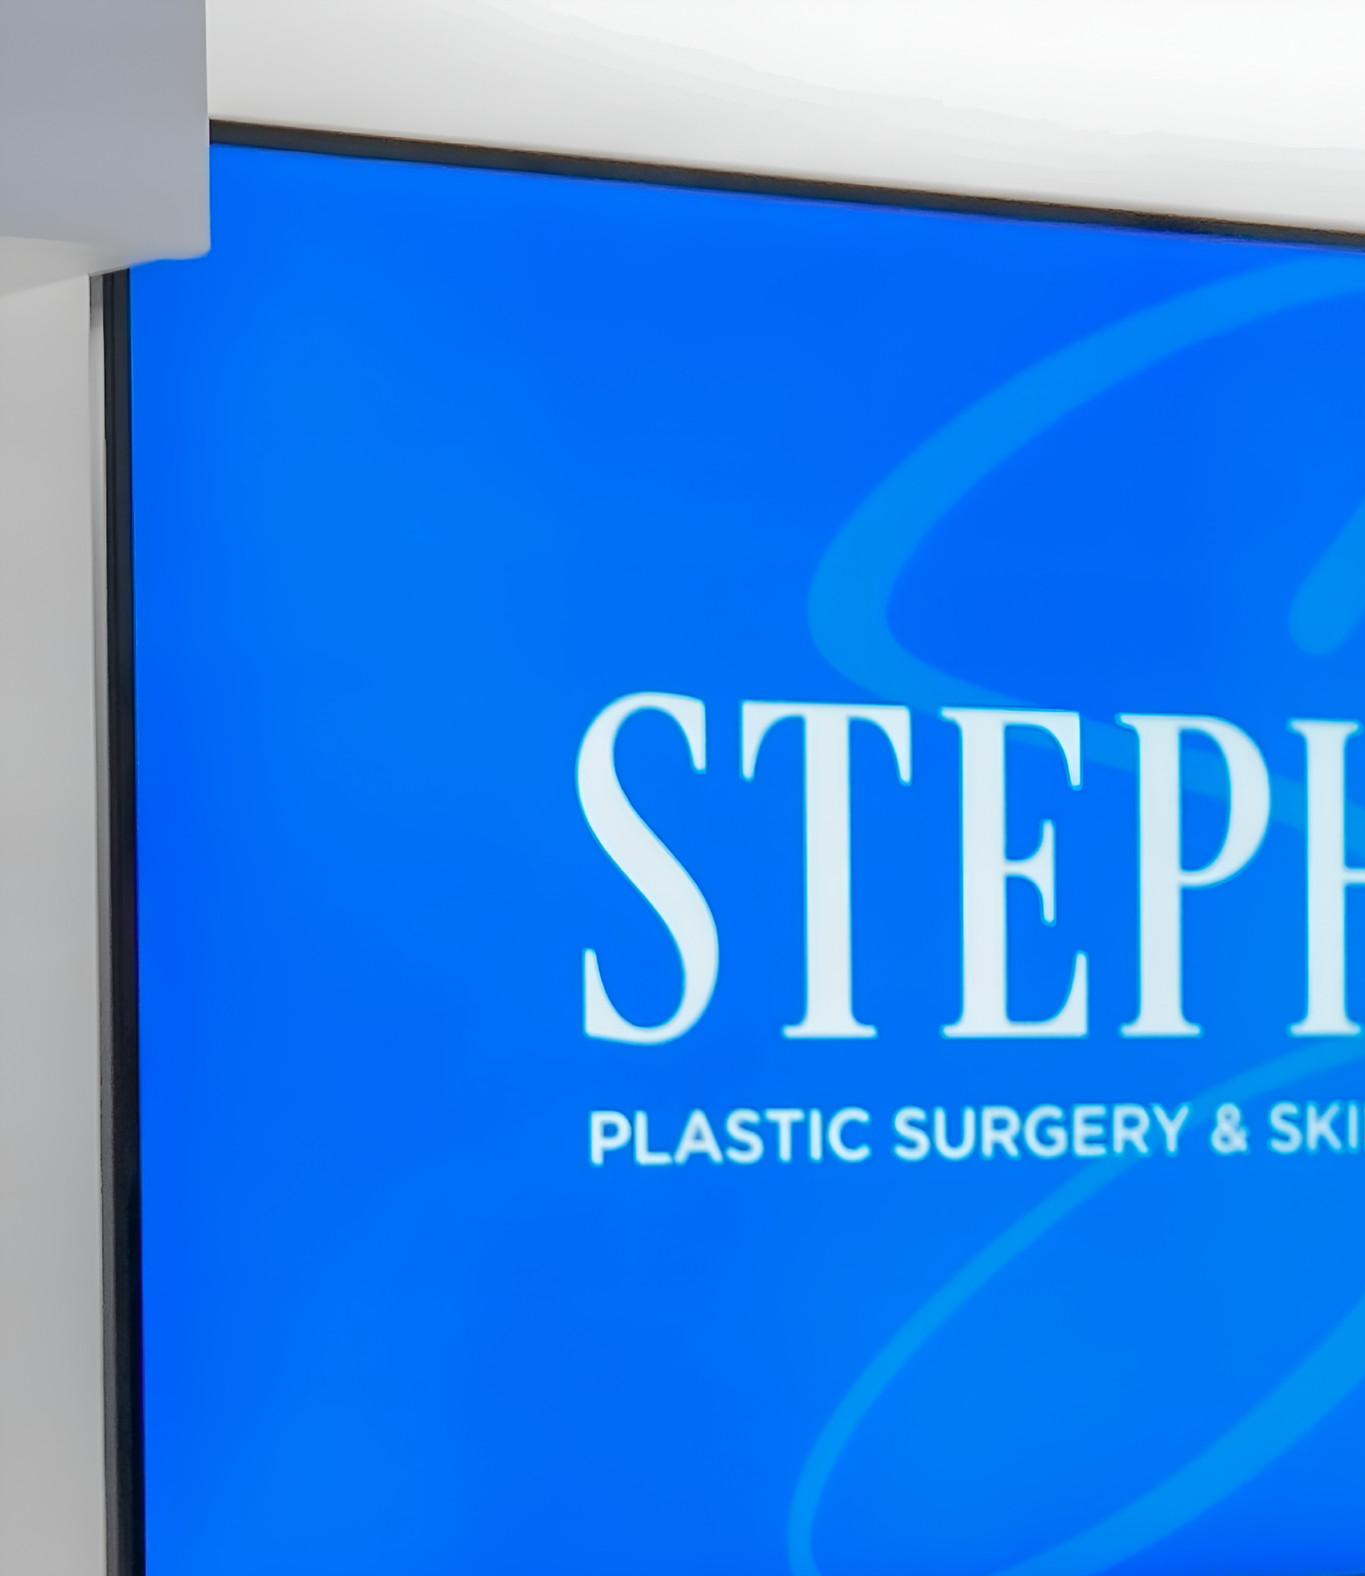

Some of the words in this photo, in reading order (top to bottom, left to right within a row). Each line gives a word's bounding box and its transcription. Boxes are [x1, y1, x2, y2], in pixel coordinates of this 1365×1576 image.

[589, 1107, 872, 1166] PLASTIC
[893, 1104, 1190, 1161] SURGERY
[1209, 1103, 1249, 1153] &
